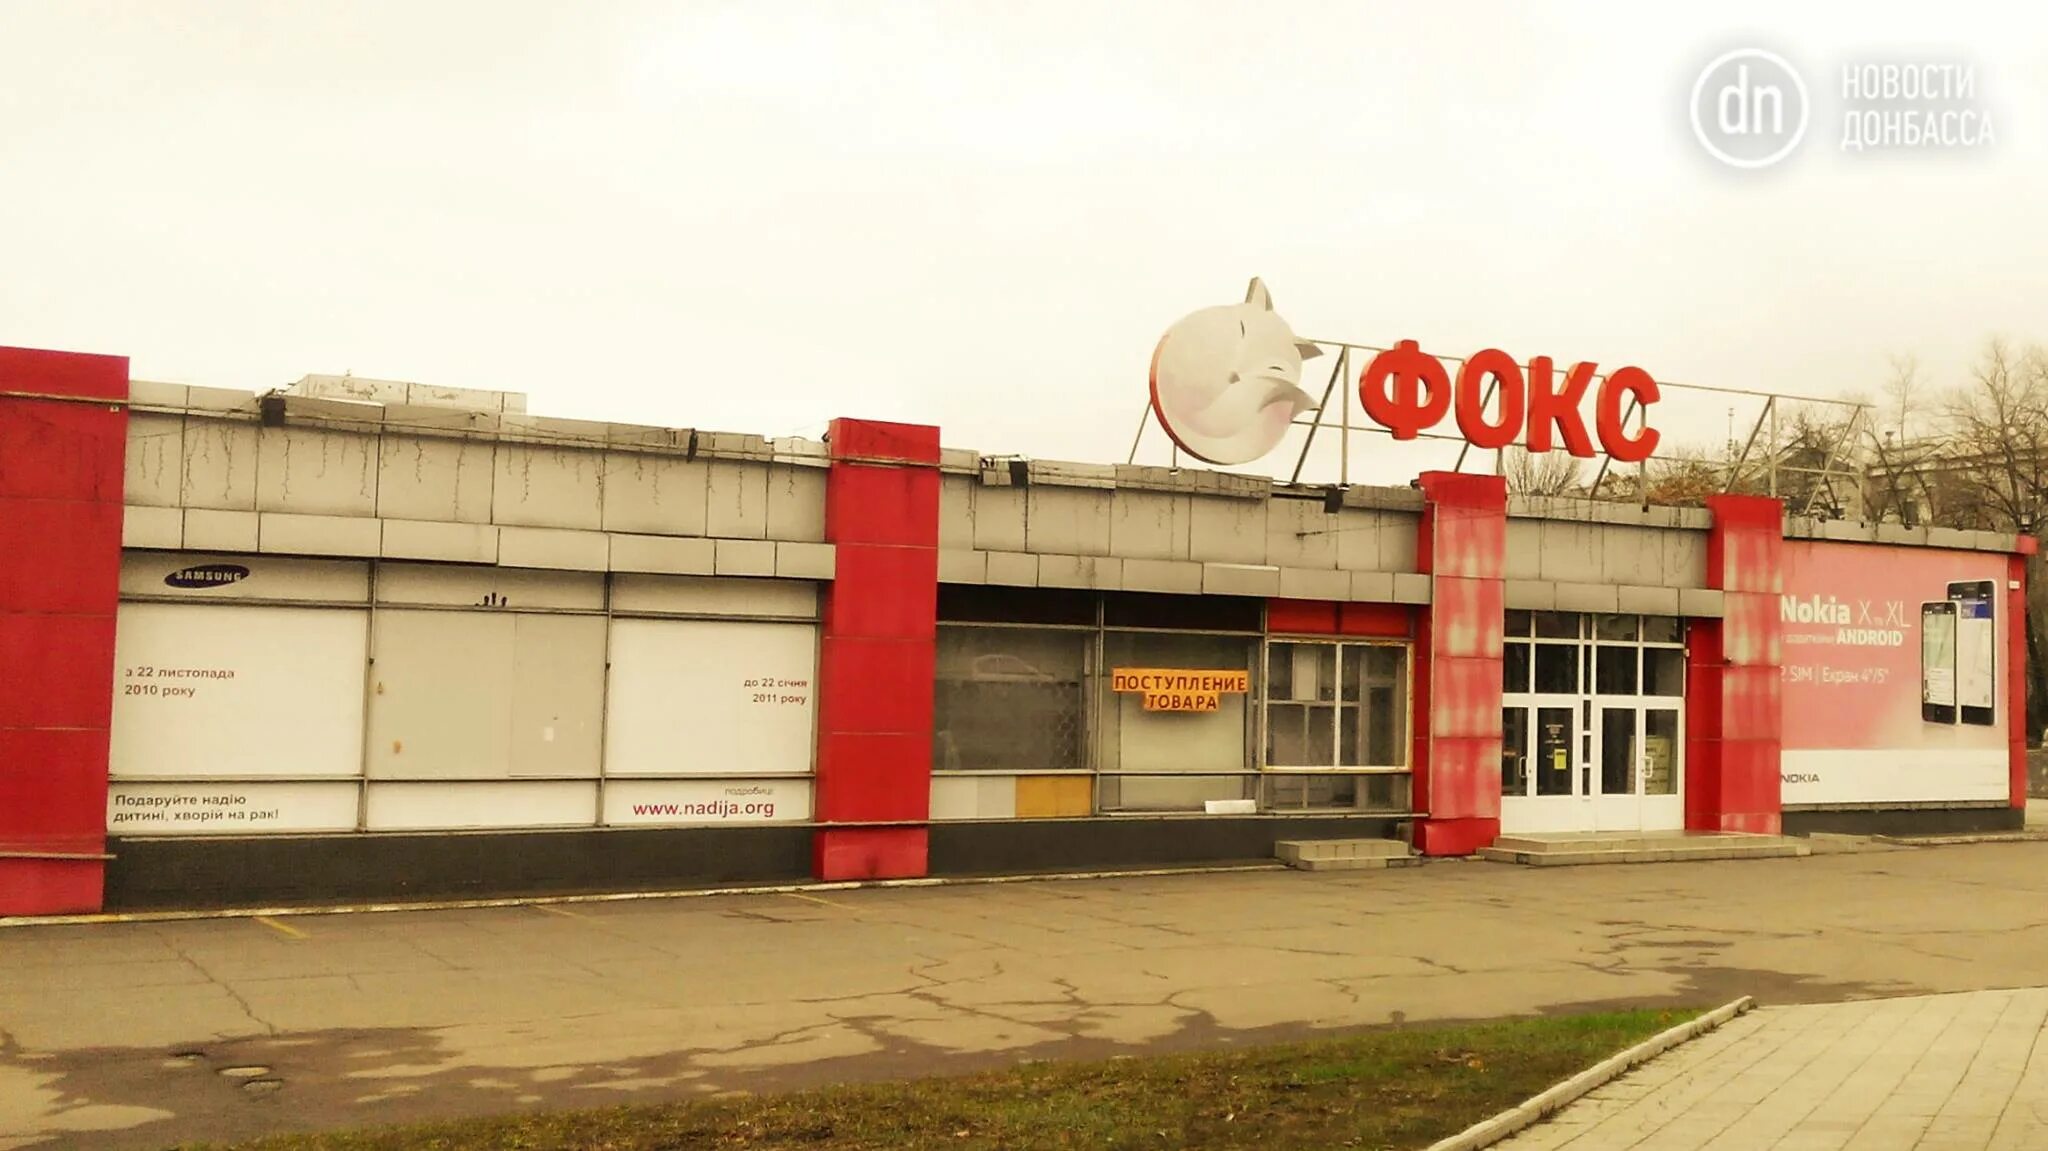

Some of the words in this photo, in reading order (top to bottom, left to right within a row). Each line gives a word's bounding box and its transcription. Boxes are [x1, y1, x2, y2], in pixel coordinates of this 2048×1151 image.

[1359, 339, 1661, 462] ФОКС
[175, 569, 241, 582] SAMSUNG
[1780, 594, 1851, 625] Nokia
[1858, 600, 1872, 625] X
[1886, 600, 1912, 628] XL
[1836, 628, 1904, 647] ANDROID
[137, 667, 153, 678] 22
[158, 669, 235, 679] листопада
[1789, 665, 1813, 682] SIM
[744, 678, 759, 689] до
[762, 677, 775, 688] 22
[777, 678, 808, 689] січня
[1115, 675, 1246, 691] ПОСТУПЛЕНИЕ
[125, 684, 158, 695] 2010
[162, 686, 196, 698] року
[752, 693, 778, 704] 2011
[781, 694, 807, 706] року
[1148, 695, 1217, 709] ТОВАРА
[1780, 773, 1820, 784] NOKIA
[115, 793, 198, 808] Подаруйте
[202, 793, 246, 806] надію
[174, 809, 223, 822] хворій
[228, 810, 245, 820] на
[632, 800, 775, 818] www.nadija.org
